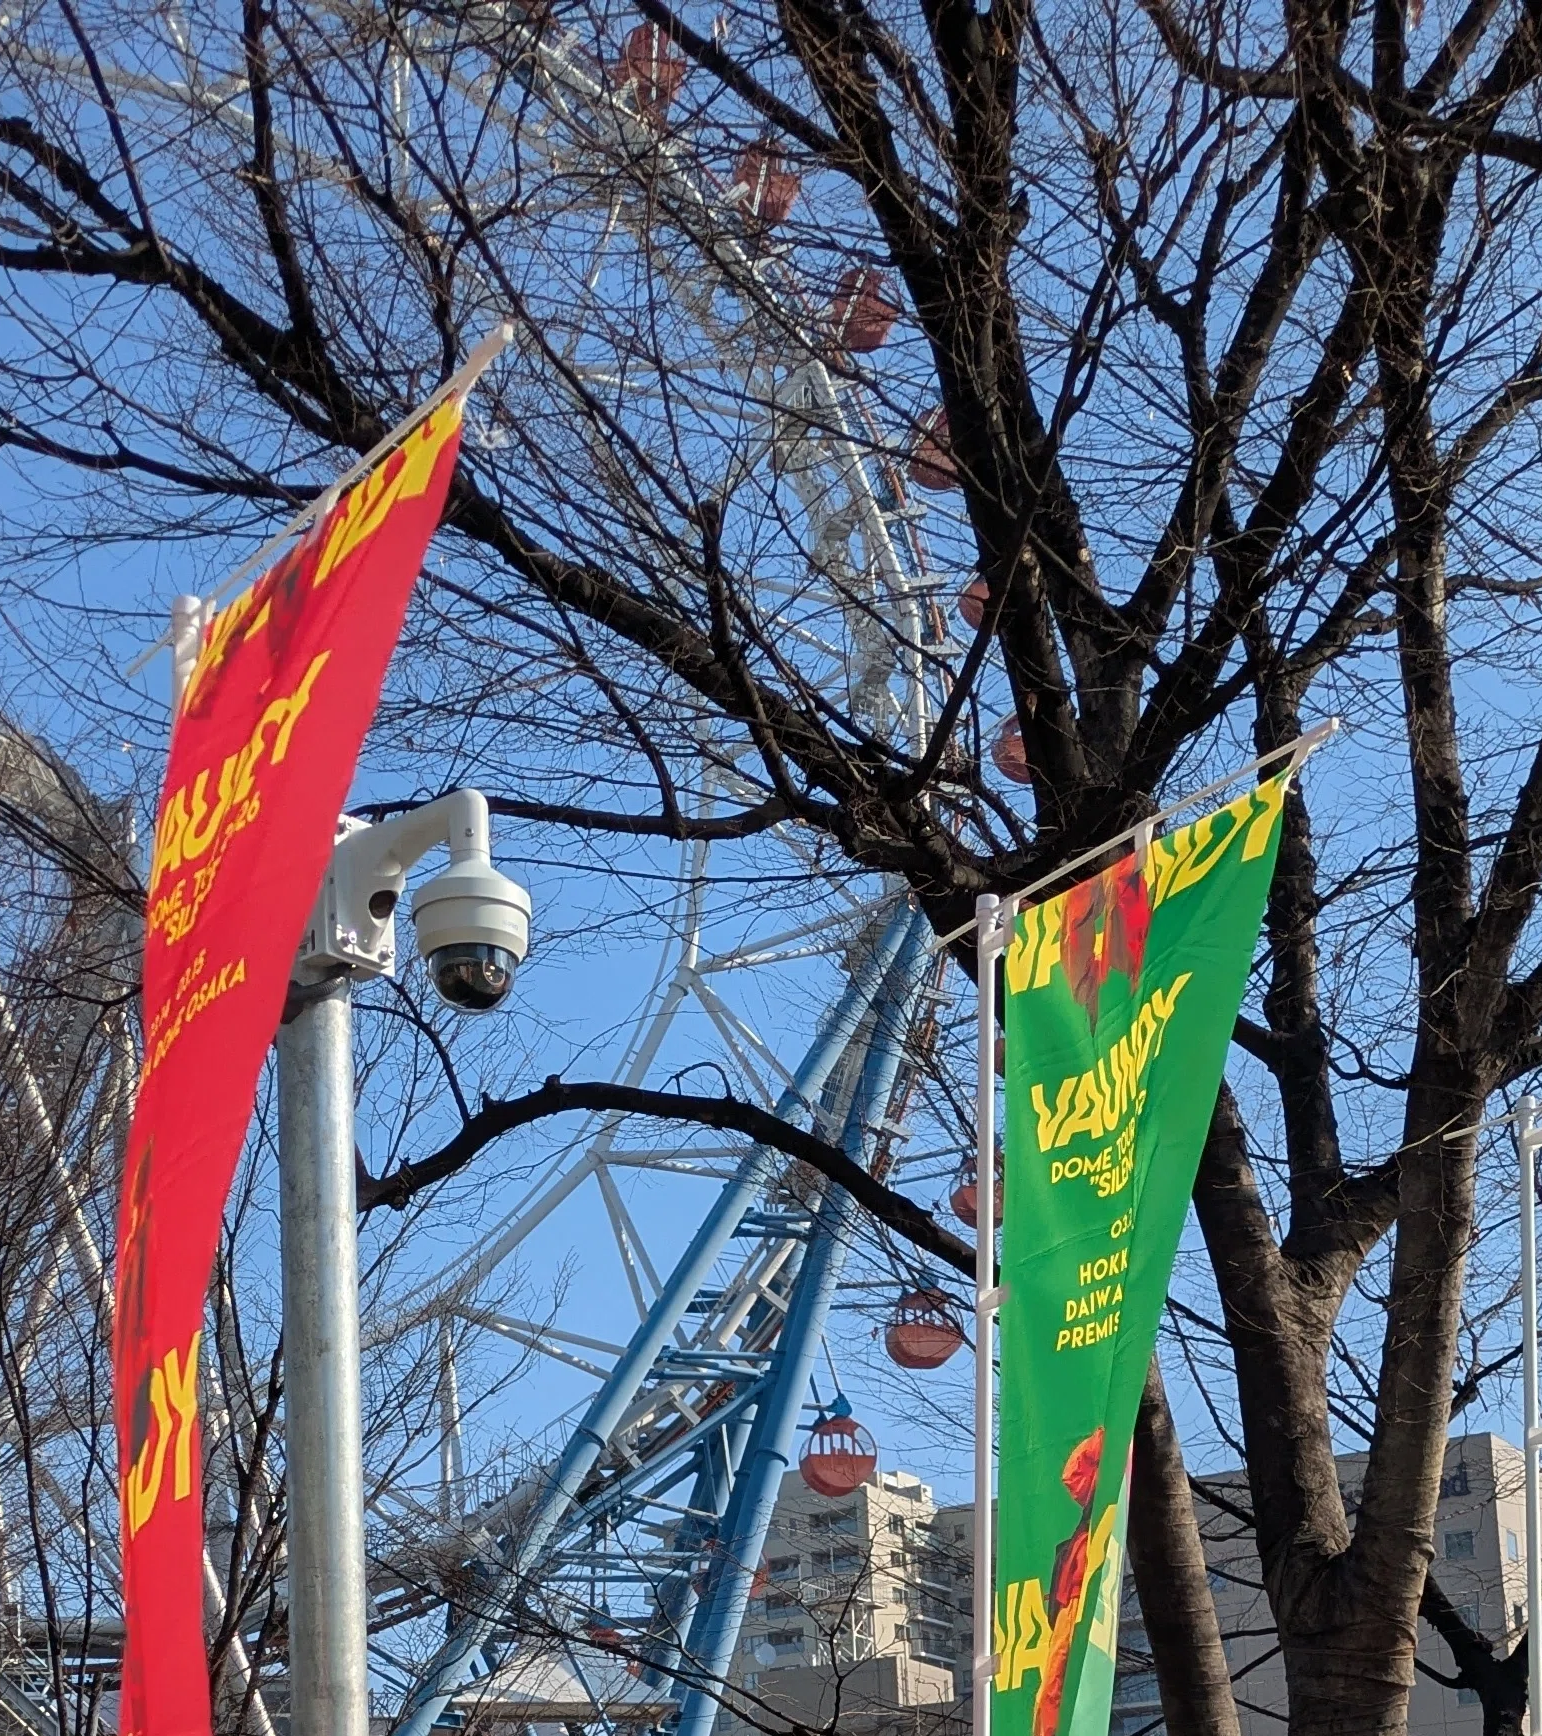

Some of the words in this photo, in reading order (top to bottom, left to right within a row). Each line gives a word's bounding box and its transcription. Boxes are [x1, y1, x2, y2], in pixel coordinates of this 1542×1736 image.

[184, 957, 246, 1022] OSAKA
[1031, 970, 1194, 1153] VAUNDY
[1051, 1145, 1112, 1184] DOME
[1065, 1282, 1124, 1323] DAIWA
